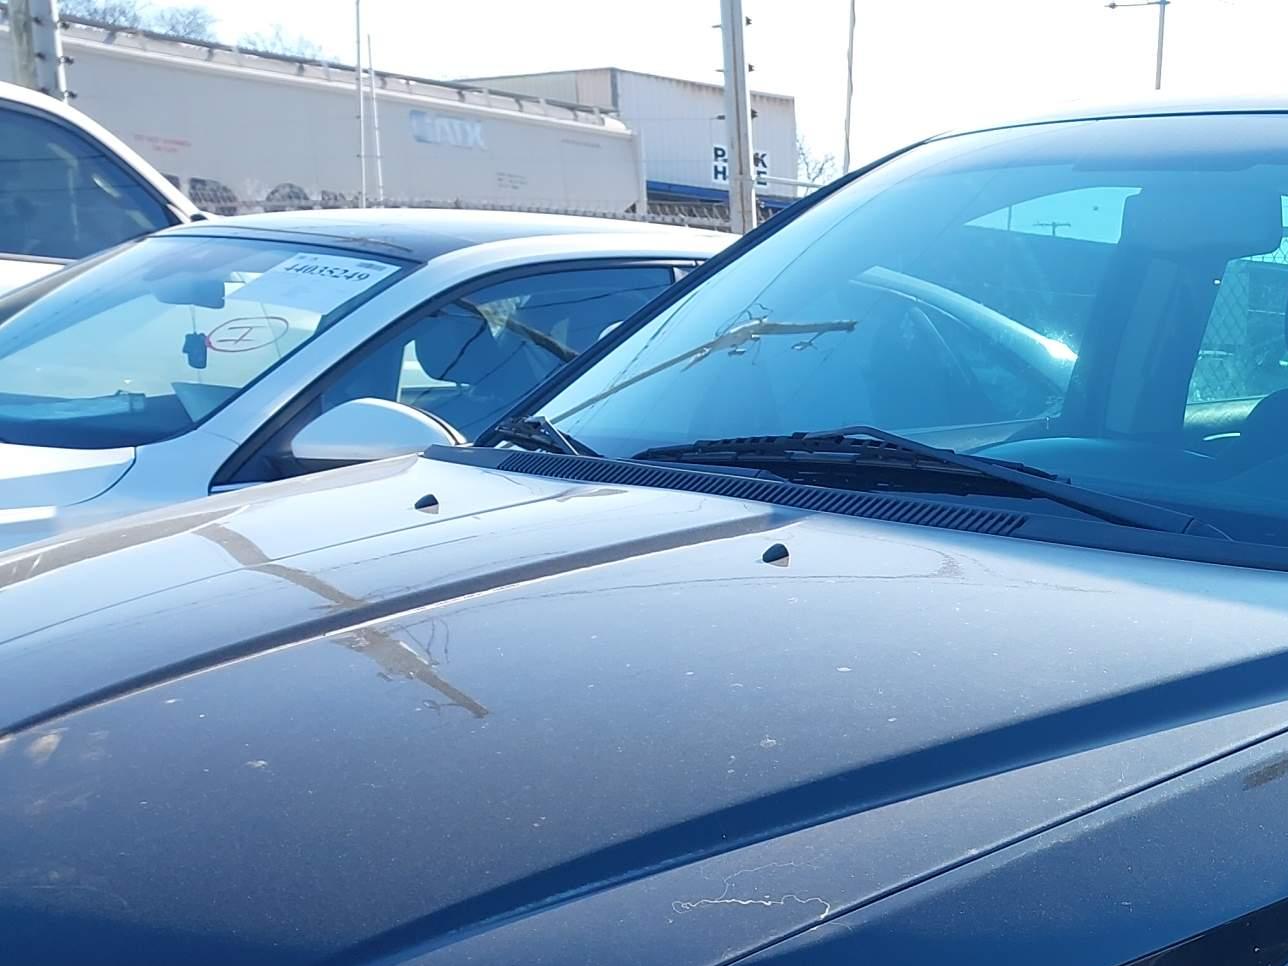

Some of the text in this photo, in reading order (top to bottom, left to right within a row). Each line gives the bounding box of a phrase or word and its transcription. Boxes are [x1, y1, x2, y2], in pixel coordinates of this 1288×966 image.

[713, 146, 767, 168] PK
[713, 165, 767, 185] HE
[284, 263, 370, 281] 44035249
